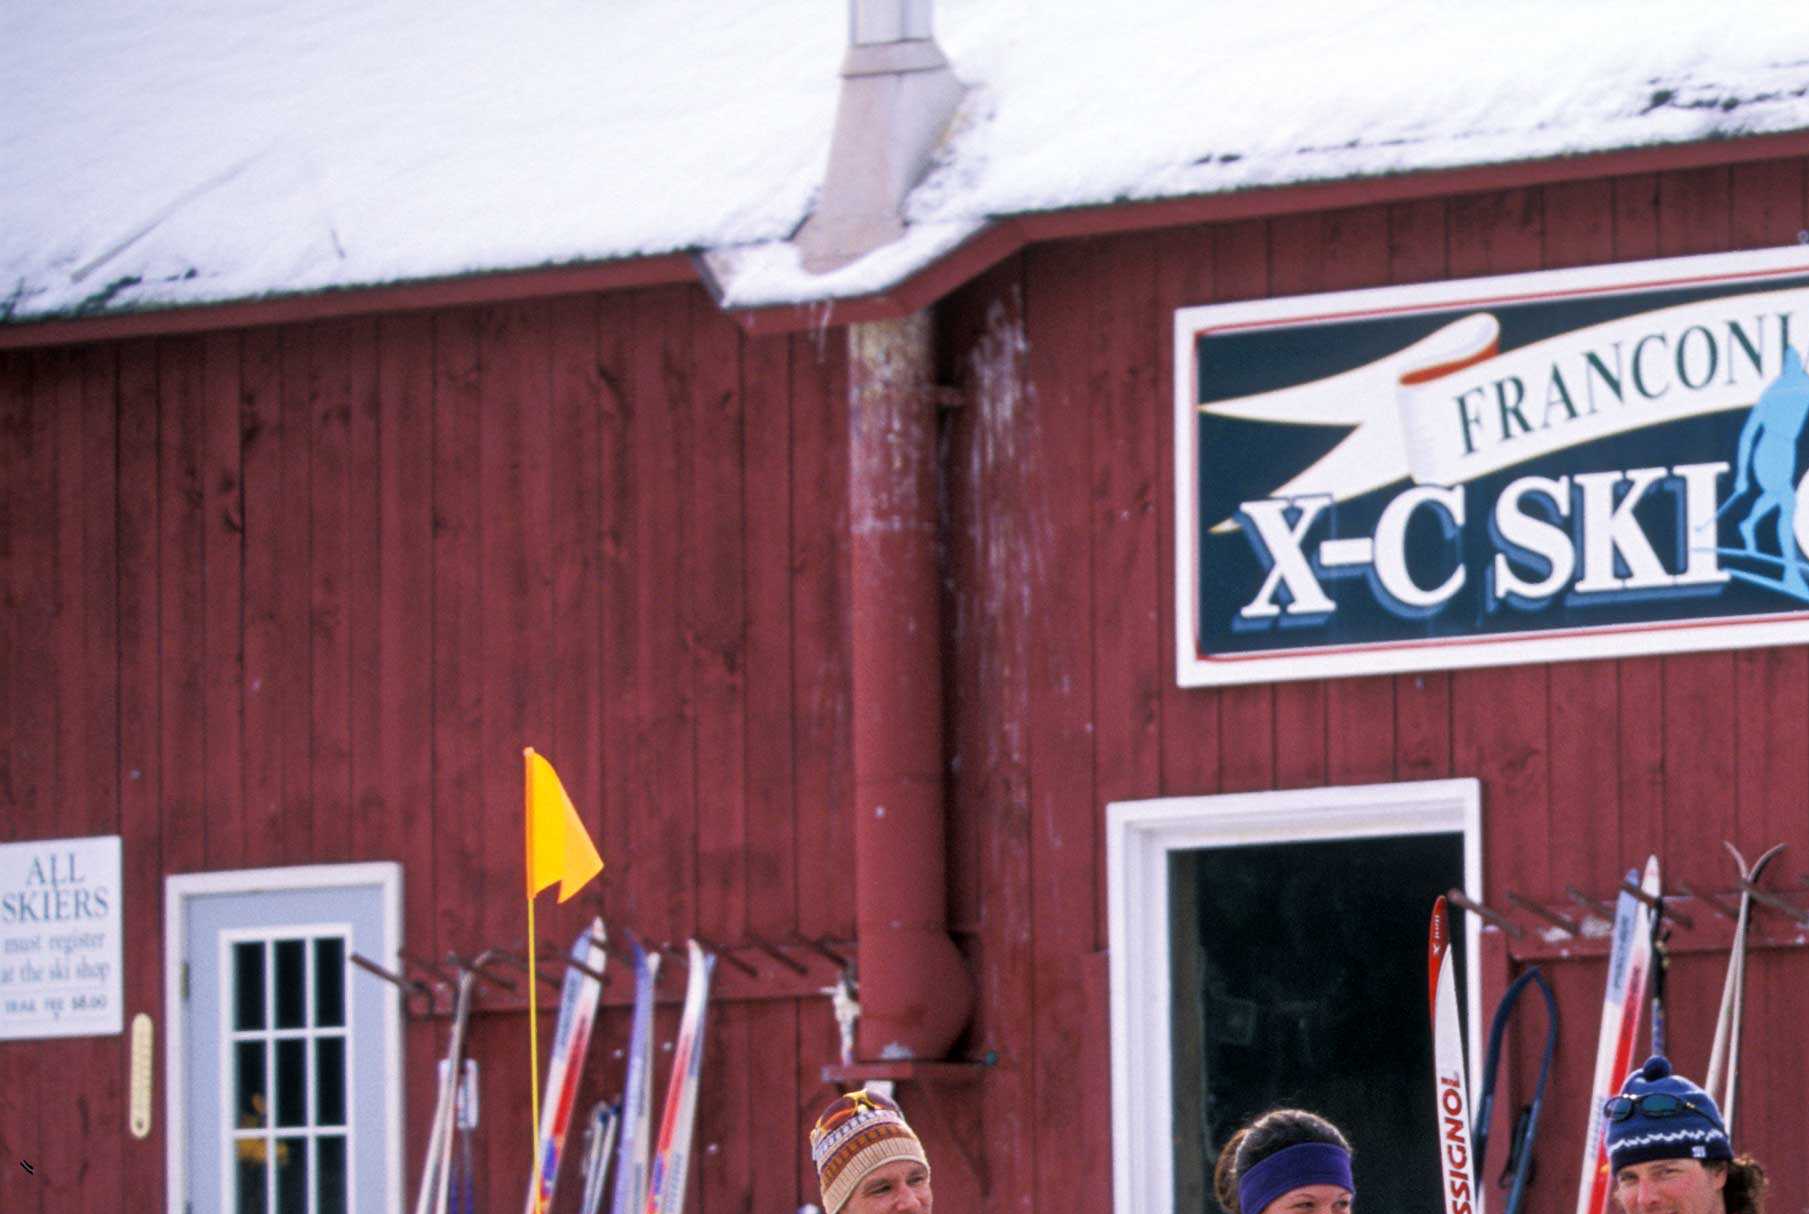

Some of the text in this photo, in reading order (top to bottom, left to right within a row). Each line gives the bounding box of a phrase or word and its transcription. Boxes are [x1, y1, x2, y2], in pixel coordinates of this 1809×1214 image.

[1236, 484, 1467, 624] X-C
[1492, 460, 1733, 601] SKI
[26, 852, 85, 886] ALL
[2, 886, 110, 923] SKIERS
[49, 931, 106, 954] register
[20, 960, 43, 983] the
[49, 958, 70, 980] ski
[76, 956, 110, 982] shop
